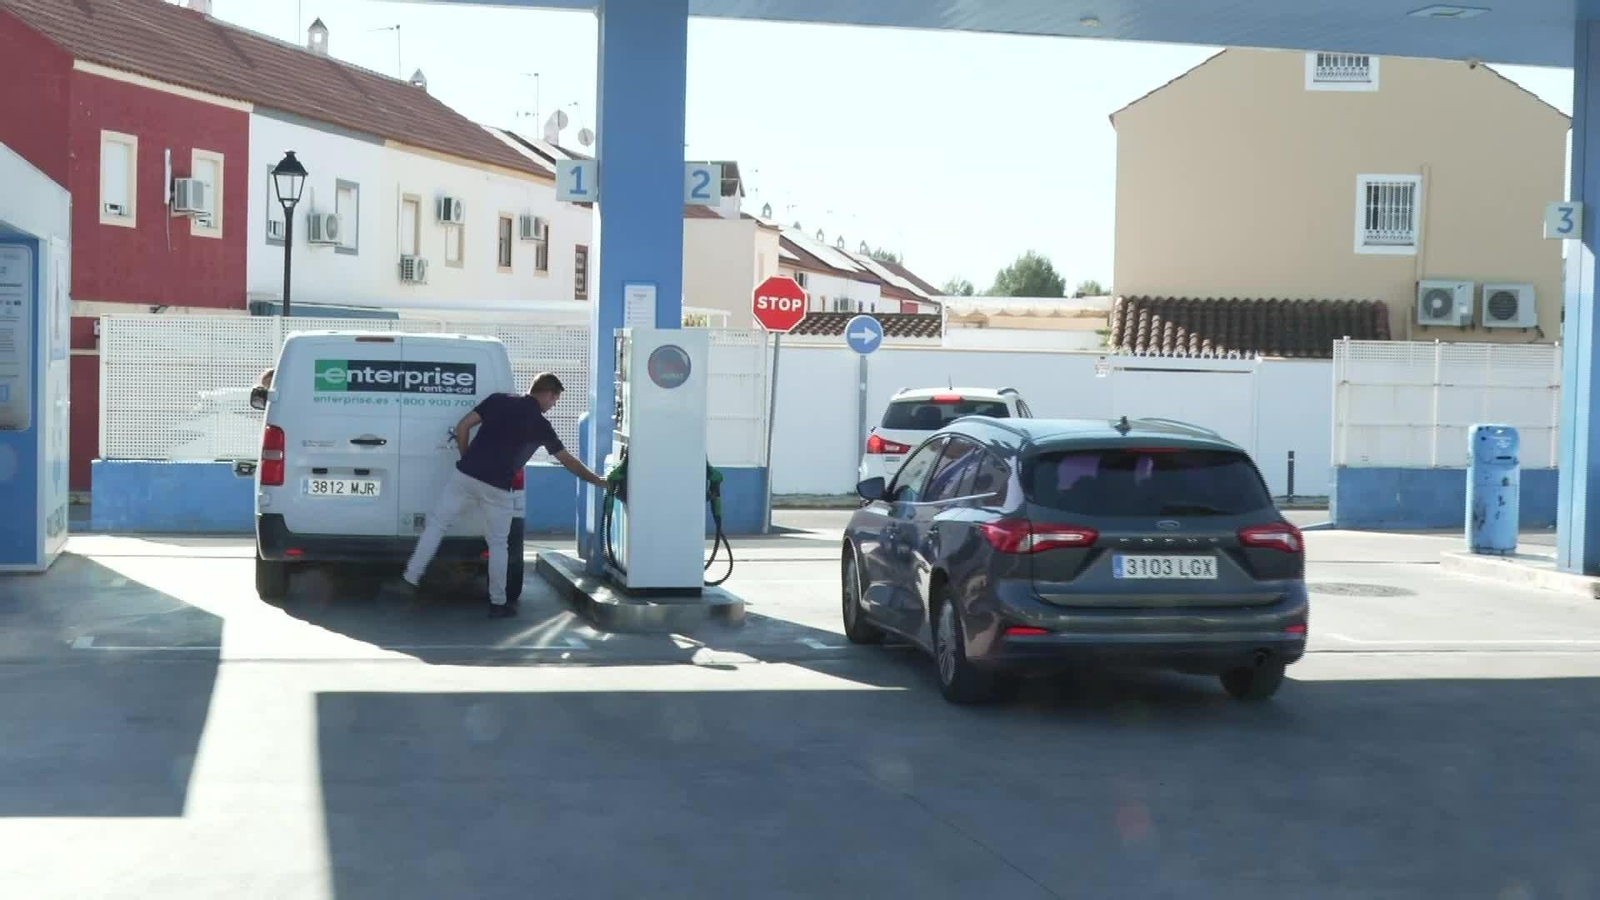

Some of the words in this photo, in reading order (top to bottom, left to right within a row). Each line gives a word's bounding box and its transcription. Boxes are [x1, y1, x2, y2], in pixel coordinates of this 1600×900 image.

[569, 166, 587, 195] 1
[691, 169, 711, 199] 2
[1557, 206, 1574, 234] 3
[757, 295, 802, 312] STOP
[323, 367, 475, 389] enterprise
[419, 385, 474, 394] rent-a-car
[313, 396, 389, 405] enterprise.es
[430, 398, 450, 407] 900
[312, 480, 344, 494] 3812
[350, 482, 375, 495] MJR
[1126, 558, 1173, 576] 3103
[1178, 558, 1213, 576] LGX
